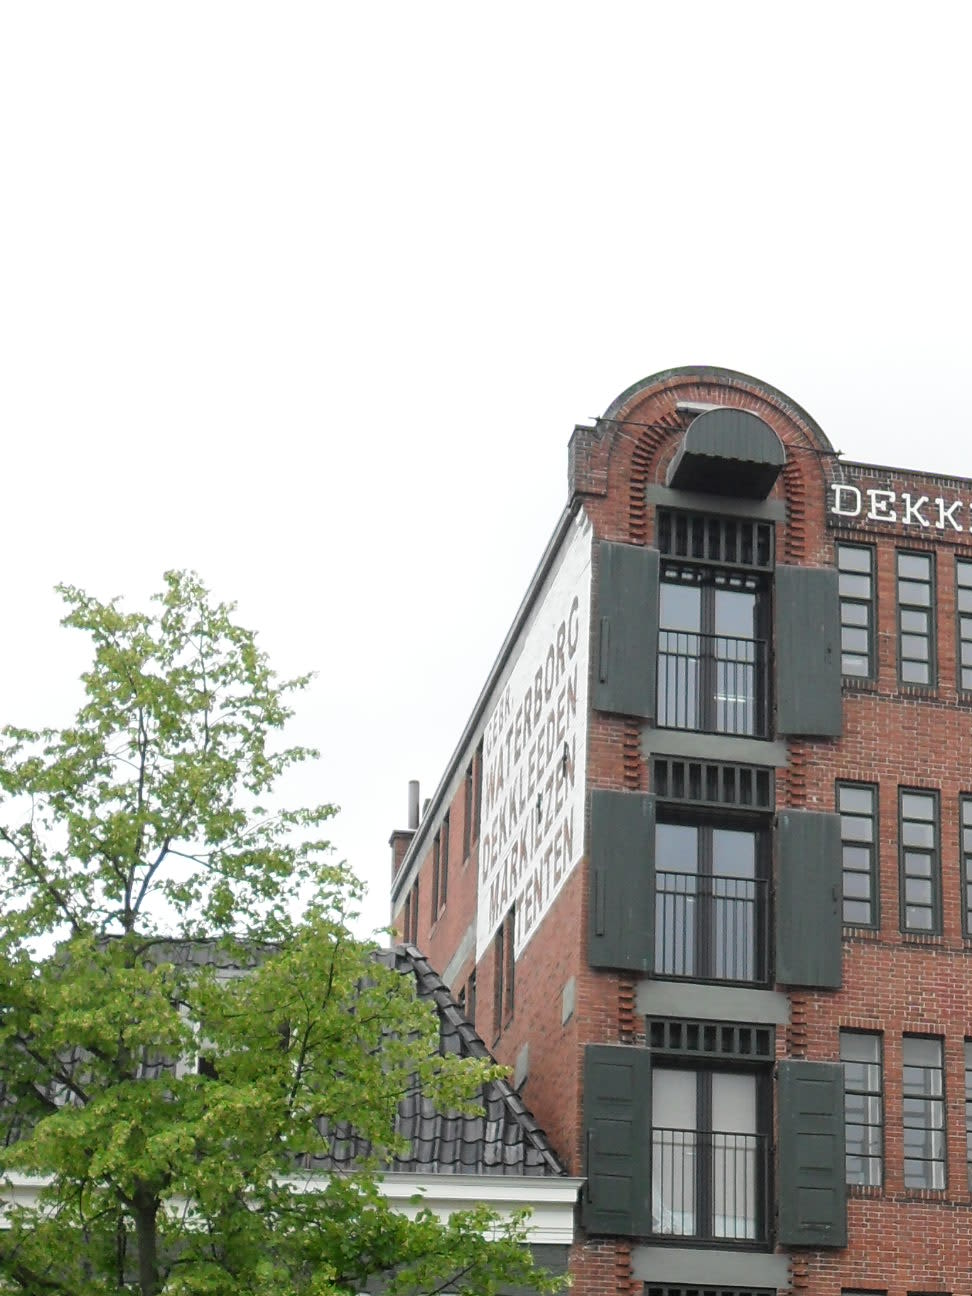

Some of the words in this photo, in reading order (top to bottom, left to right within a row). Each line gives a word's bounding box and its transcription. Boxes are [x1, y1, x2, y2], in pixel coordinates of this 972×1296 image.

[481, 663, 578, 885] DEKKLEEDEN
[485, 595, 579, 822] WATERBORG
[488, 732, 576, 935] MARKIEZEN
[515, 805, 573, 946] TENTEN
